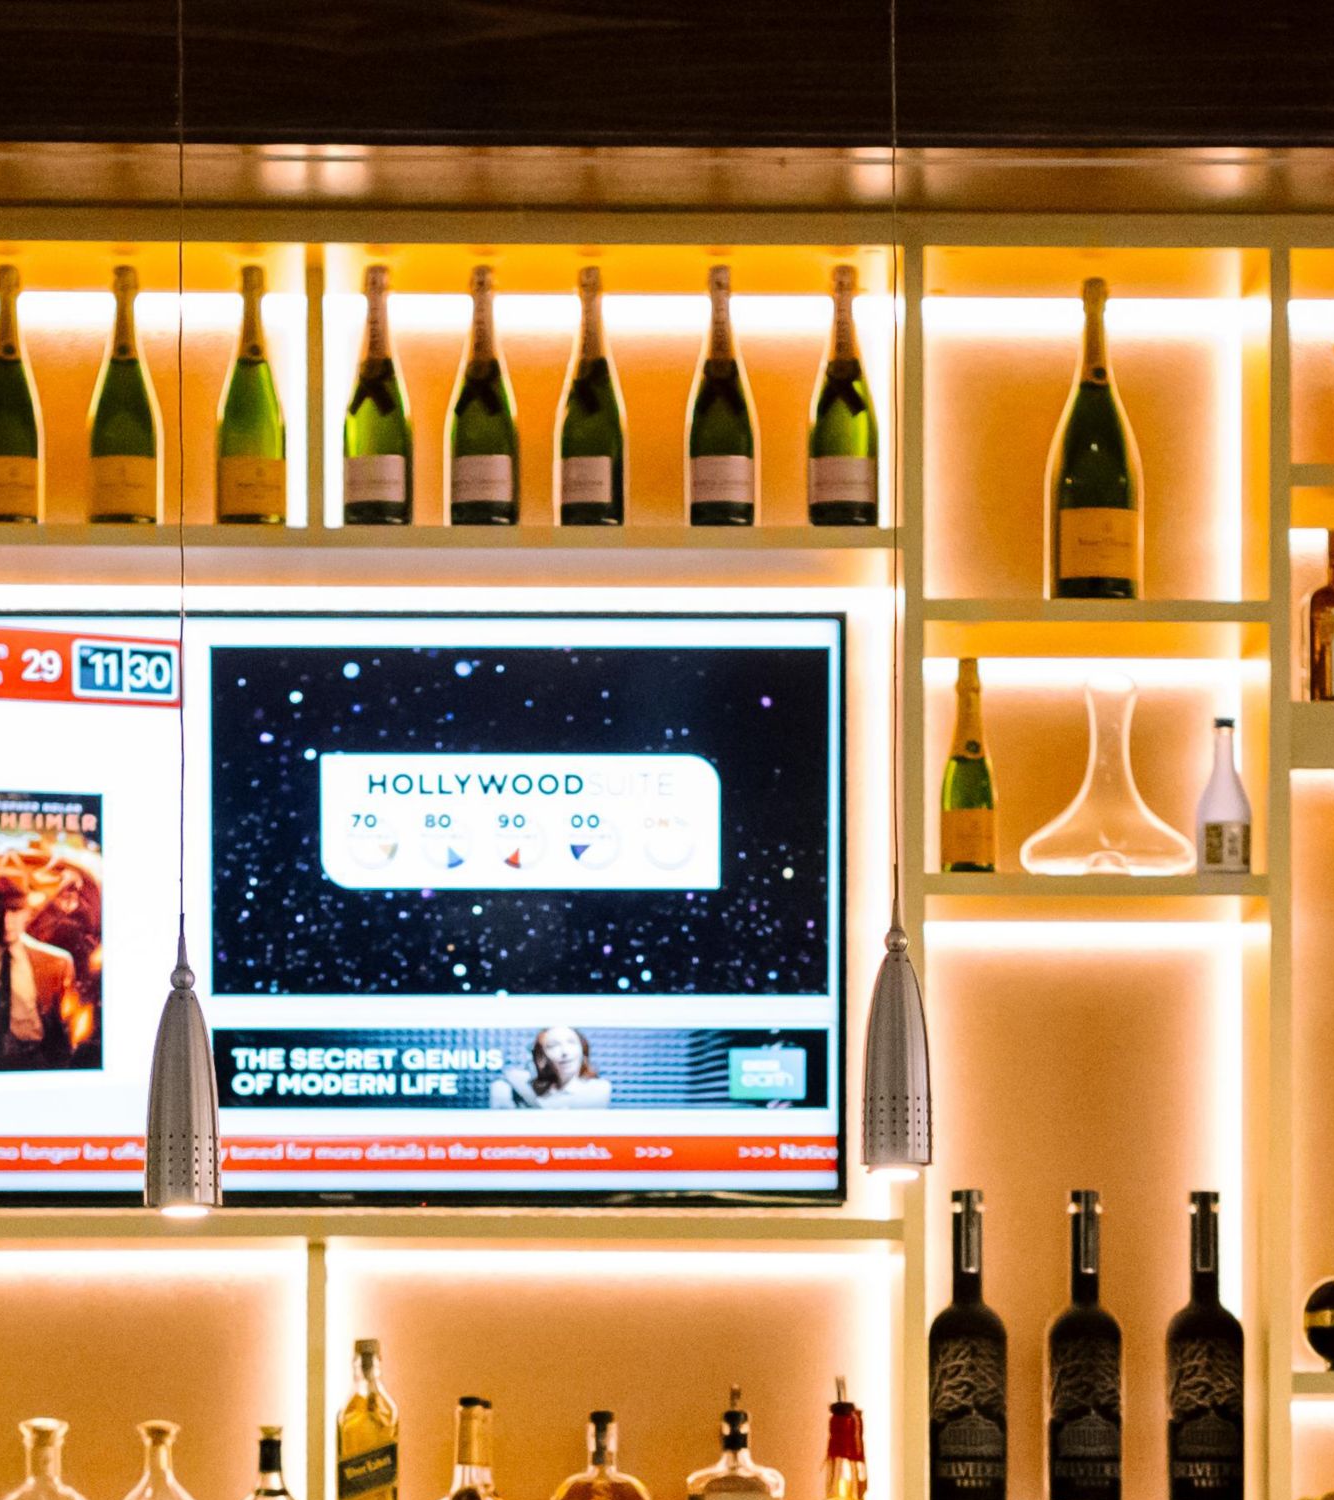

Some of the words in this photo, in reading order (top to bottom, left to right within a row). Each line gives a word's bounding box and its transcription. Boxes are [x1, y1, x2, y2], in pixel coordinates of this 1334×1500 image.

[21, 648, 62, 682] 29
[368, 773, 584, 795] HOLLYWOOD
[351, 814, 377, 829] 70
[424, 814, 451, 829] 80
[498, 814, 525, 829] 90
[231, 1048, 285, 1070] THE
[290, 1048, 397, 1070] SECRET
[402, 1048, 503, 1070] GENIUS
[231, 1073, 273, 1095] OF
[277, 1073, 397, 1095] MODERN
[401, 1073, 458, 1095] LIFE
